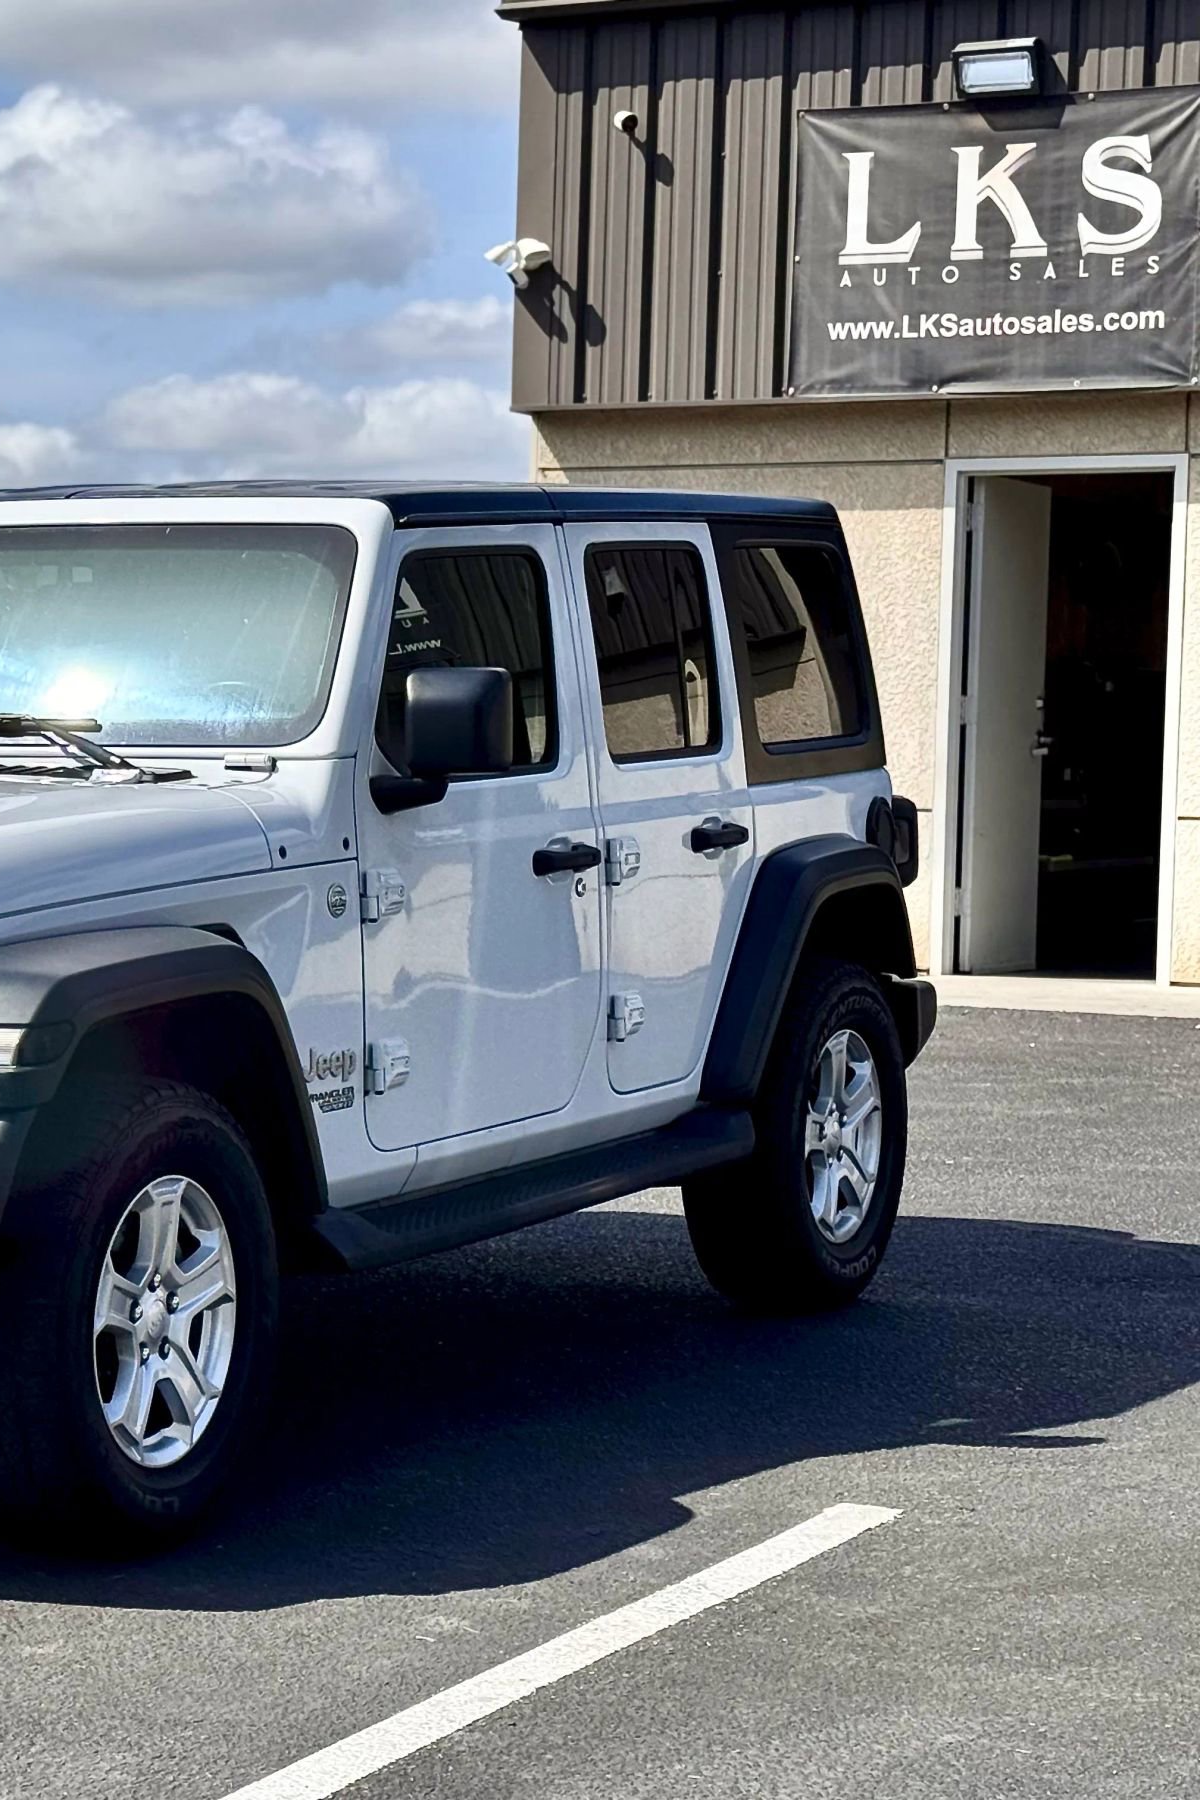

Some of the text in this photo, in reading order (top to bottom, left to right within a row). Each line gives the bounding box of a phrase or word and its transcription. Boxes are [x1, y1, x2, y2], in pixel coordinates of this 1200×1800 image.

[838, 134, 1162, 265] LKS
[839, 256, 1160, 287] AUTO SALES
[827, 309, 1165, 340] www.LKSautosales.com
[303, 1047, 356, 1083] Jeep
